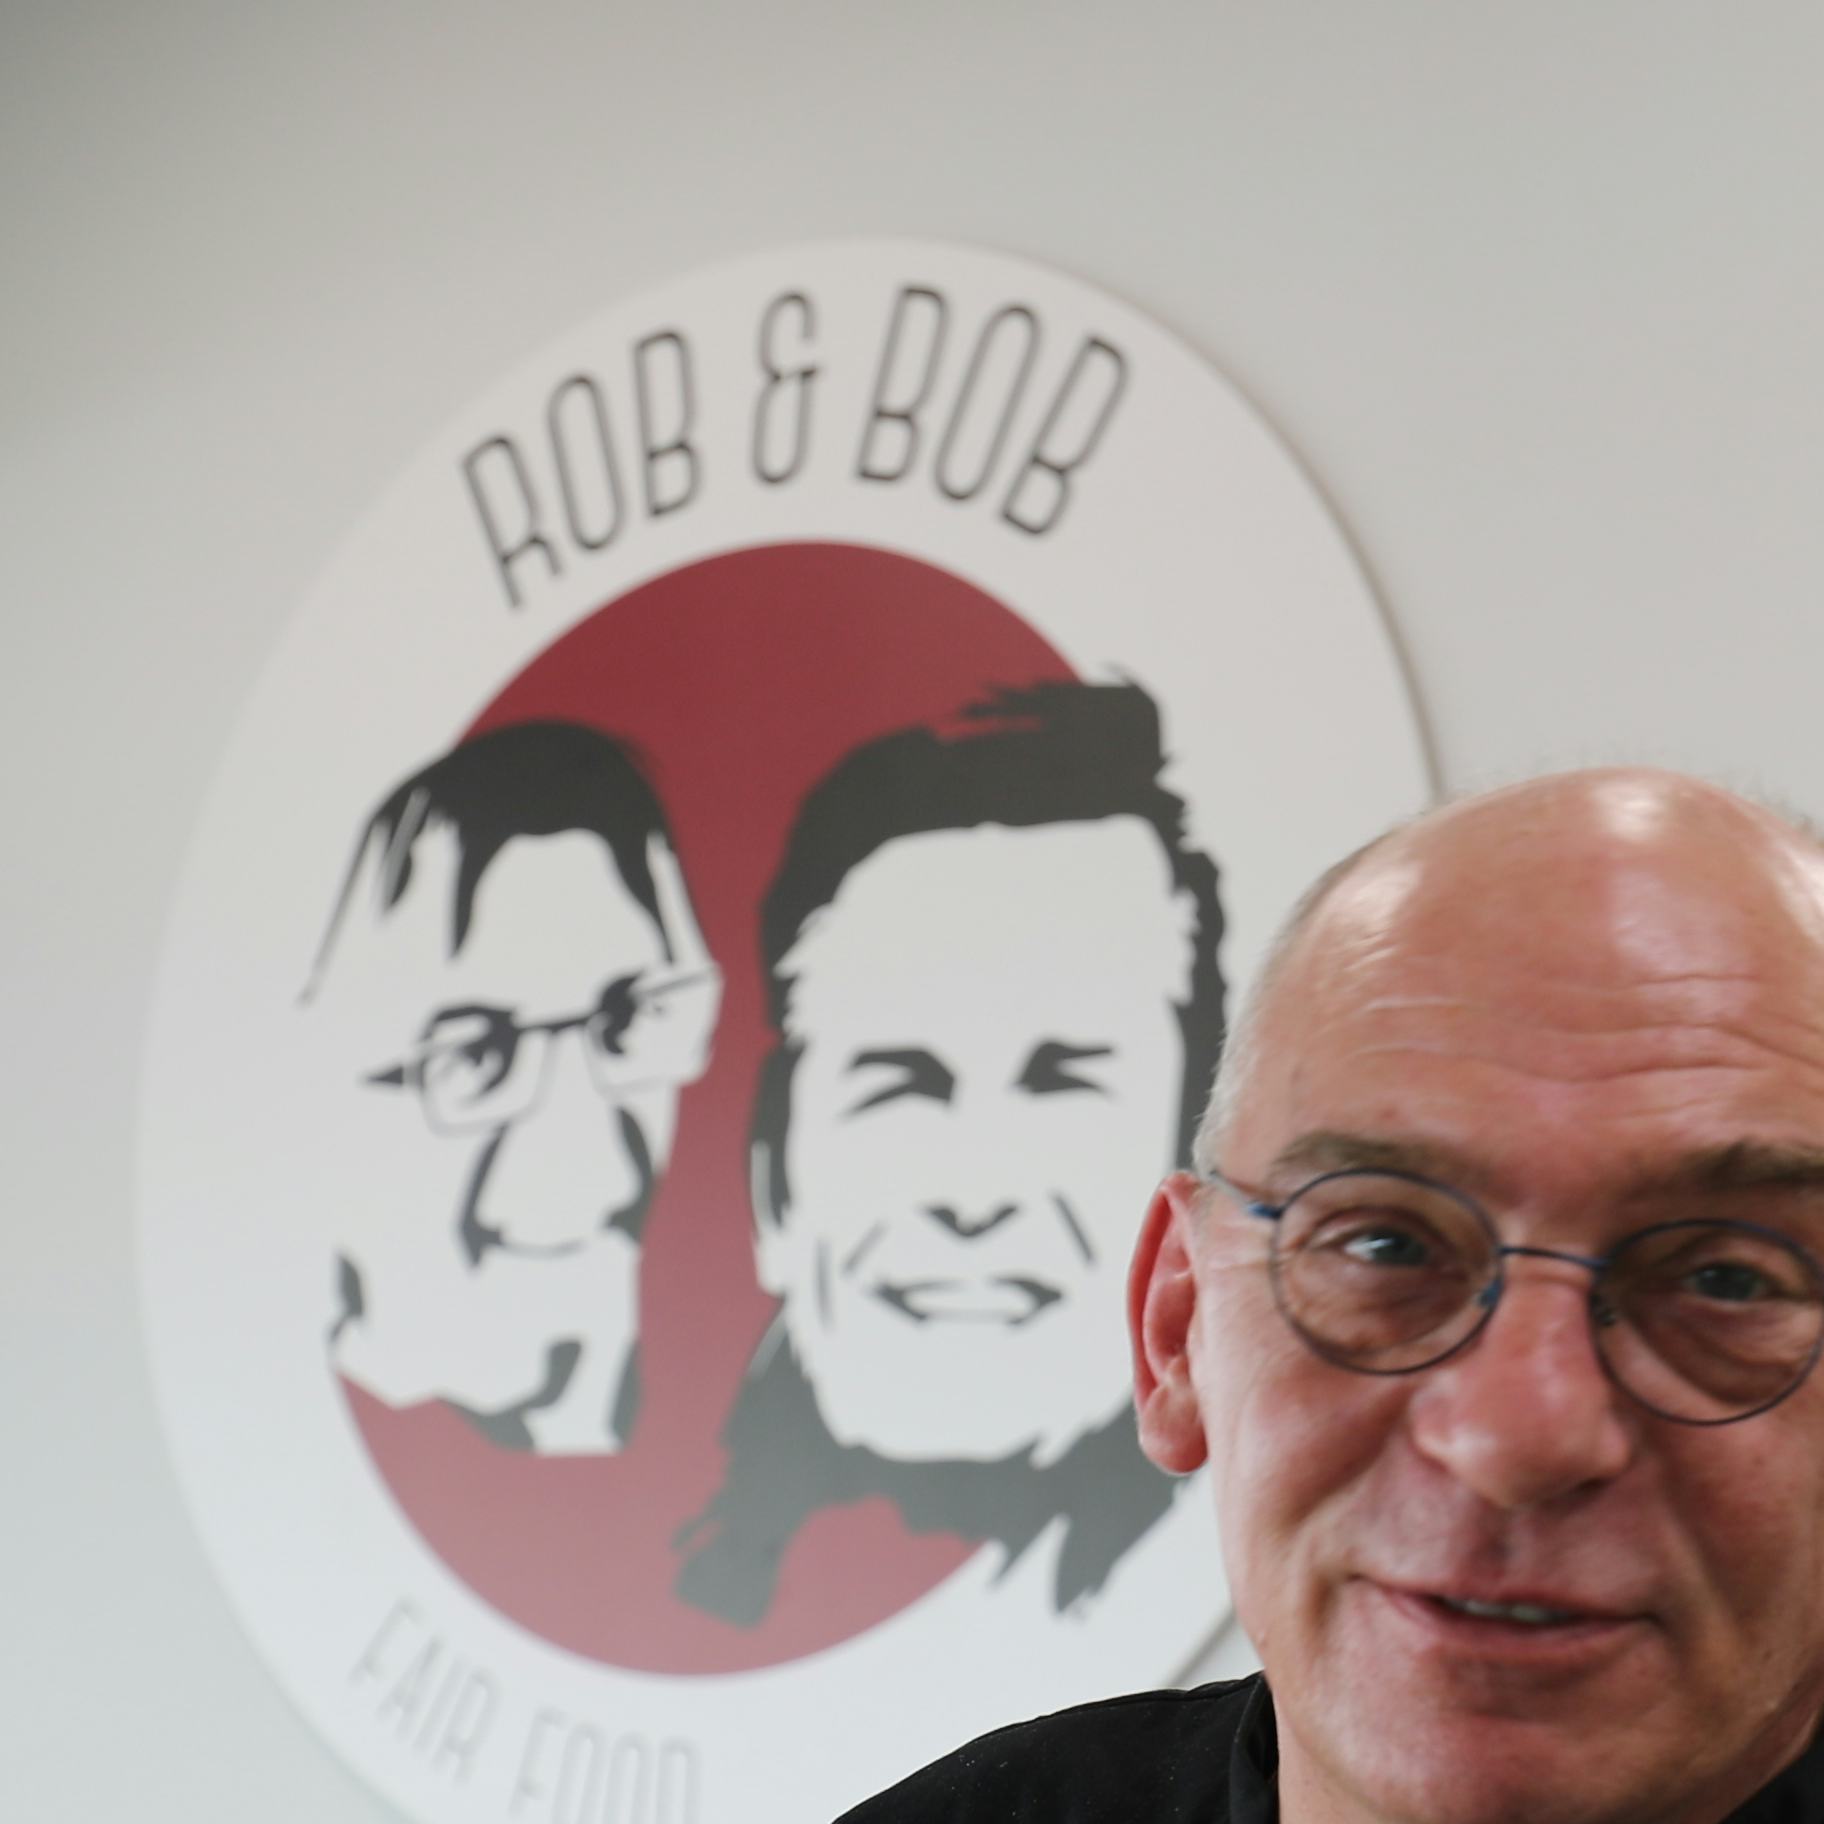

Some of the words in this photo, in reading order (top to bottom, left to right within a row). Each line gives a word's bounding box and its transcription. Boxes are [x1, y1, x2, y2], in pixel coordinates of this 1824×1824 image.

[460, 327, 704, 608] ROB
[748, 288, 823, 487] &
[854, 283, 1130, 537] BOB
[347, 1594, 504, 1786] FAIR
